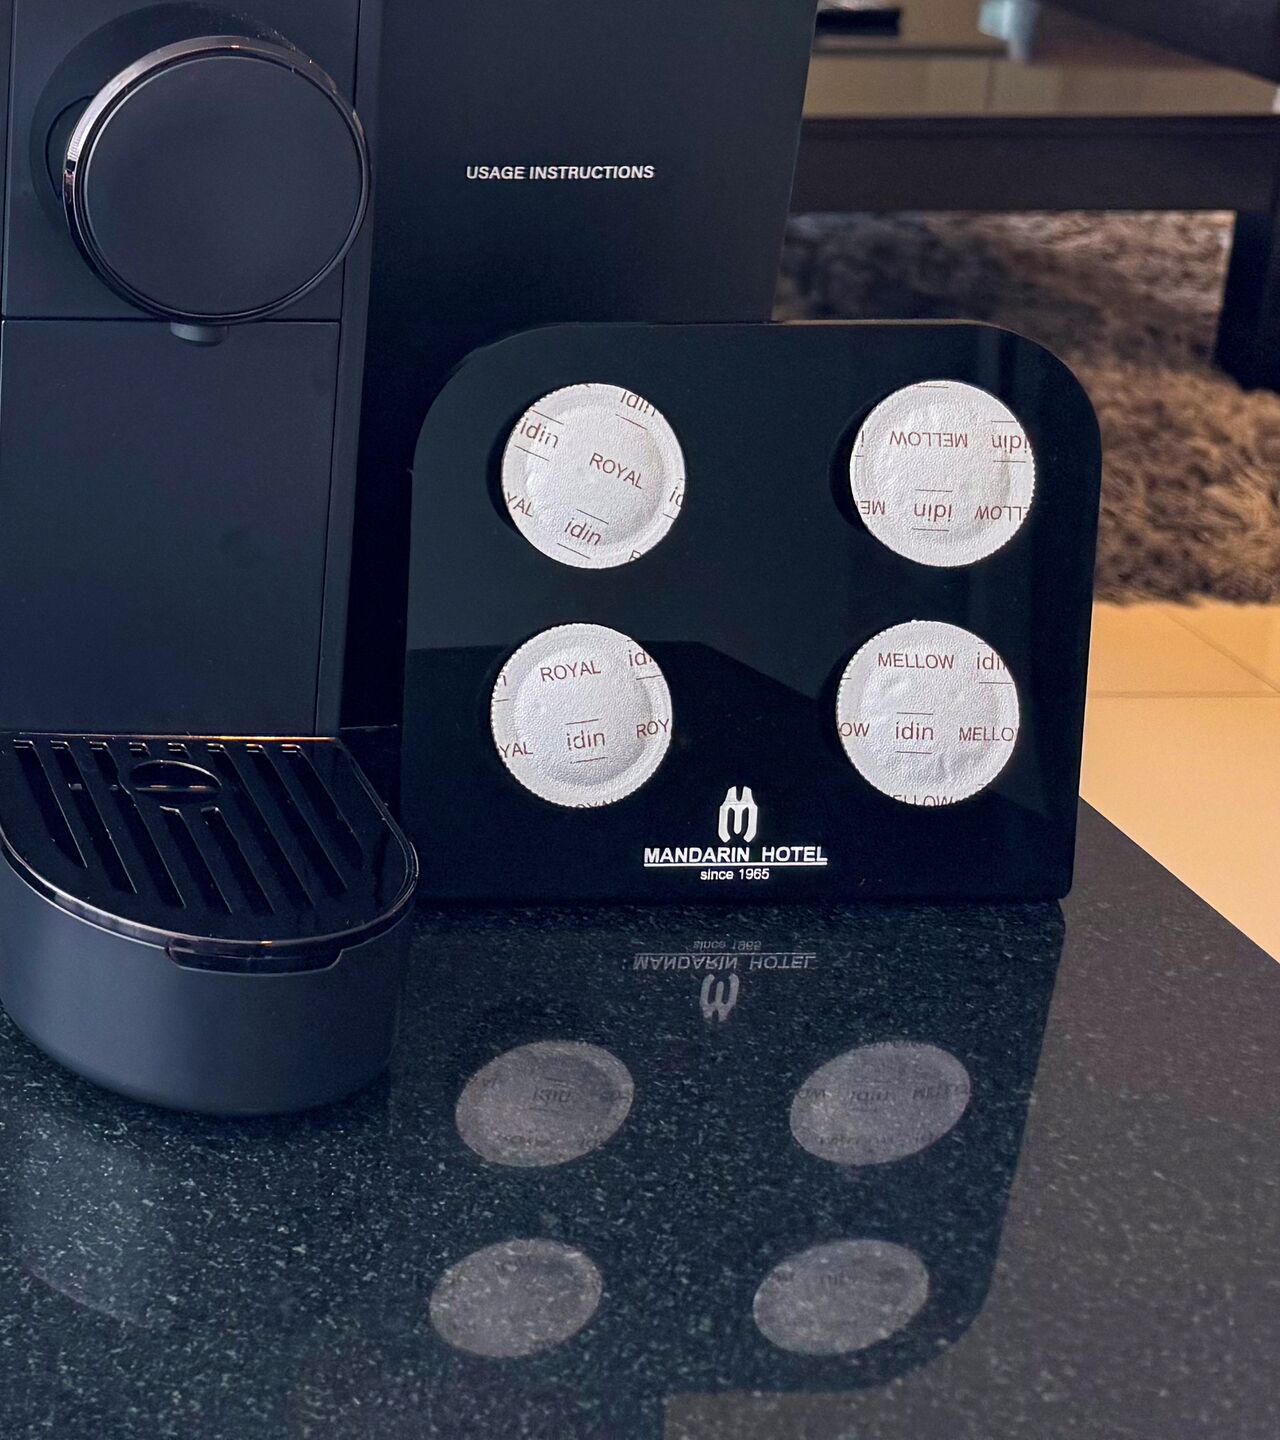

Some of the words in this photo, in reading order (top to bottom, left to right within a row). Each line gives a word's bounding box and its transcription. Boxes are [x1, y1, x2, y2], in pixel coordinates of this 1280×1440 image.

[466, 166, 525, 180] USAGE
[529, 165, 655, 180] INSTRUCTIONS
[520, 417, 560, 448] idin
[890, 430, 968, 448] MELLOW
[589, 452, 643, 490] ROYAL
[506, 491, 534, 518] YAL
[914, 502, 952, 523] idin
[564, 517, 602, 546] idin
[540, 660, 602, 682] ROYAL
[877, 652, 955, 670] MELLOW
[636, 718, 670, 739] ROY
[895, 721, 934, 741] idin
[958, 727, 1018, 742] MELLO
[500, 740, 533, 759] YAL
[566, 729, 606, 751] idin
[644, 847, 750, 863] MANDARIN
[762, 846, 828, 862] HOTEL
[700, 868, 734, 880] since
[739, 868, 770, 880] 1965
